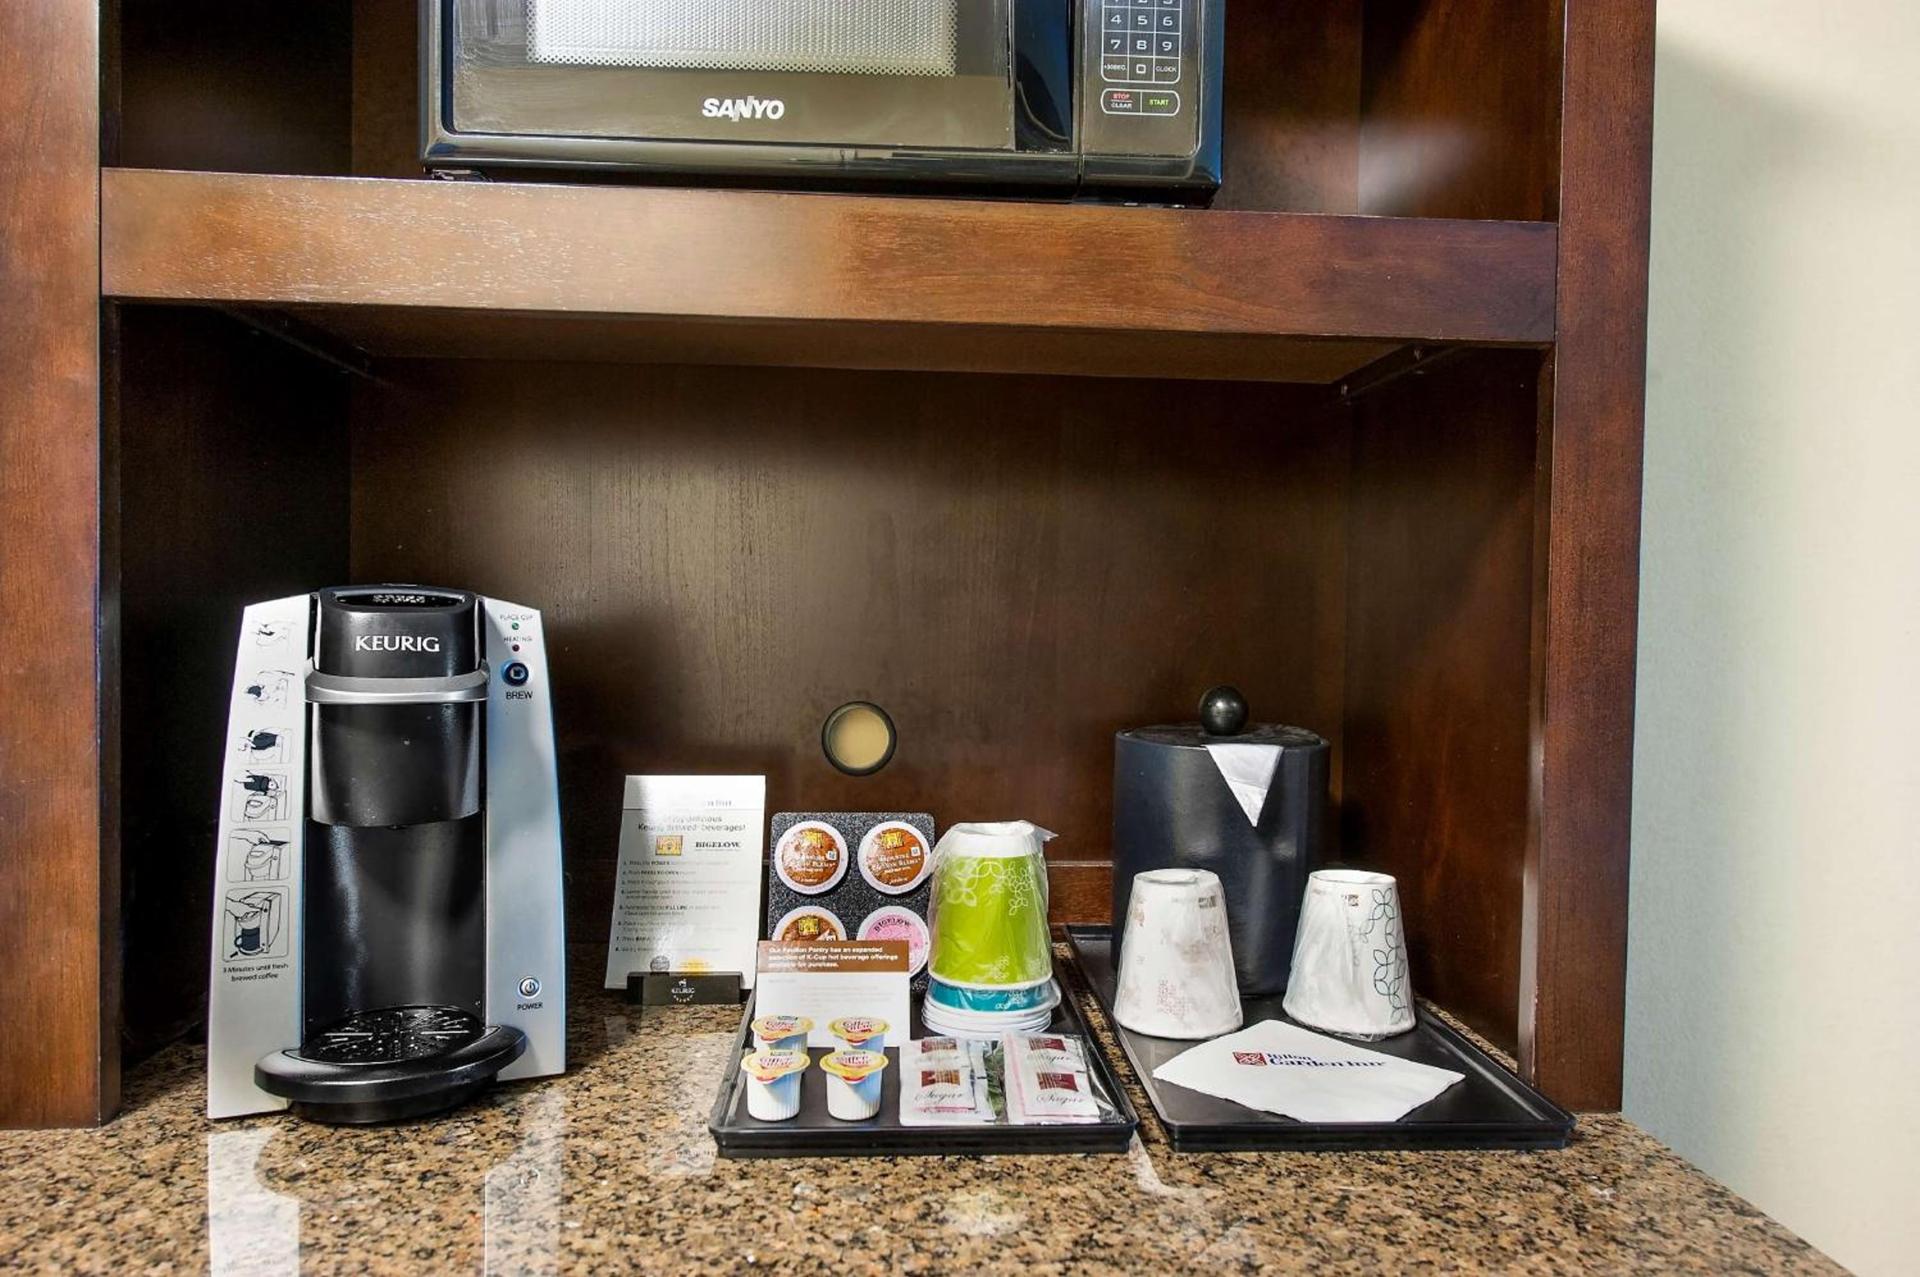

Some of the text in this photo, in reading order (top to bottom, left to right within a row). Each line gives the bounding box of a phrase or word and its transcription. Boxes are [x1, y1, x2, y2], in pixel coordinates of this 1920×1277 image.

[1110, 14, 1122, 25] 4
[1137, 15, 1148, 25] 5
[1162, 16, 1173, 26] 6
[1110, 39, 1121, 50] 7
[1136, 40, 1147, 50] 8
[1162, 41, 1172, 51] 9
[1155, 65, 1177, 73] CLOCK
[701, 95, 785, 122] SANYO
[355, 635, 440, 652] KEURIG
[506, 691, 533, 700] BREW
[873, 917, 912, 933] BIGELOW
[808, 946, 828, 954] Pantry
[852, 946, 883, 954] expanded
[870, 954, 898, 962] offerings
[231, 972, 279, 982] brewed coffee
[516, 1002, 543, 1011] POWER
[1267, 1052, 1312, 1062] Hilton
[1268, 1057, 1383, 1068] Garden Inn
